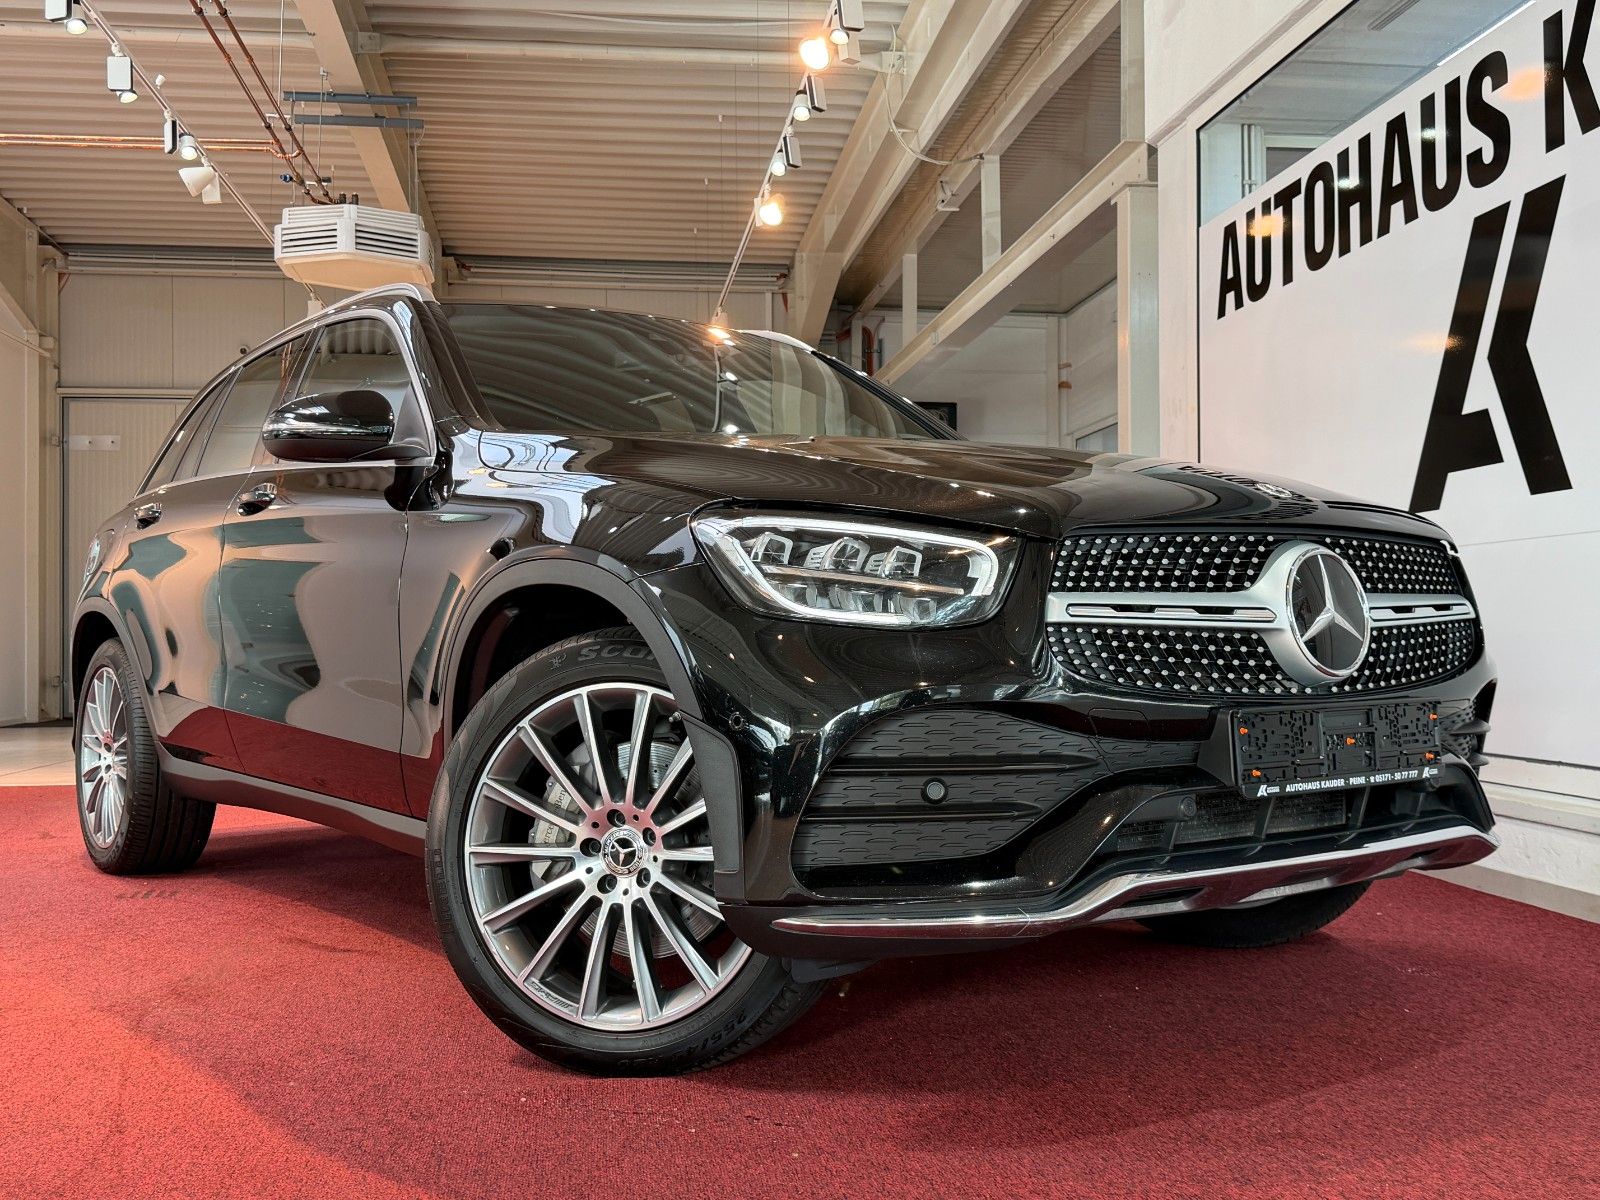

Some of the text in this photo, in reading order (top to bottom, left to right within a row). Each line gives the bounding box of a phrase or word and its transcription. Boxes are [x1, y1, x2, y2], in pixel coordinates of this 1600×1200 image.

[1217, 50, 1512, 320] AUTOHAUS
[577, 644, 656, 661] SCO
[1285, 780, 1320, 793] AUTOHAUS
[1321, 778, 1345, 789] KAUDER
[1349, 776, 1366, 786] PEINE
